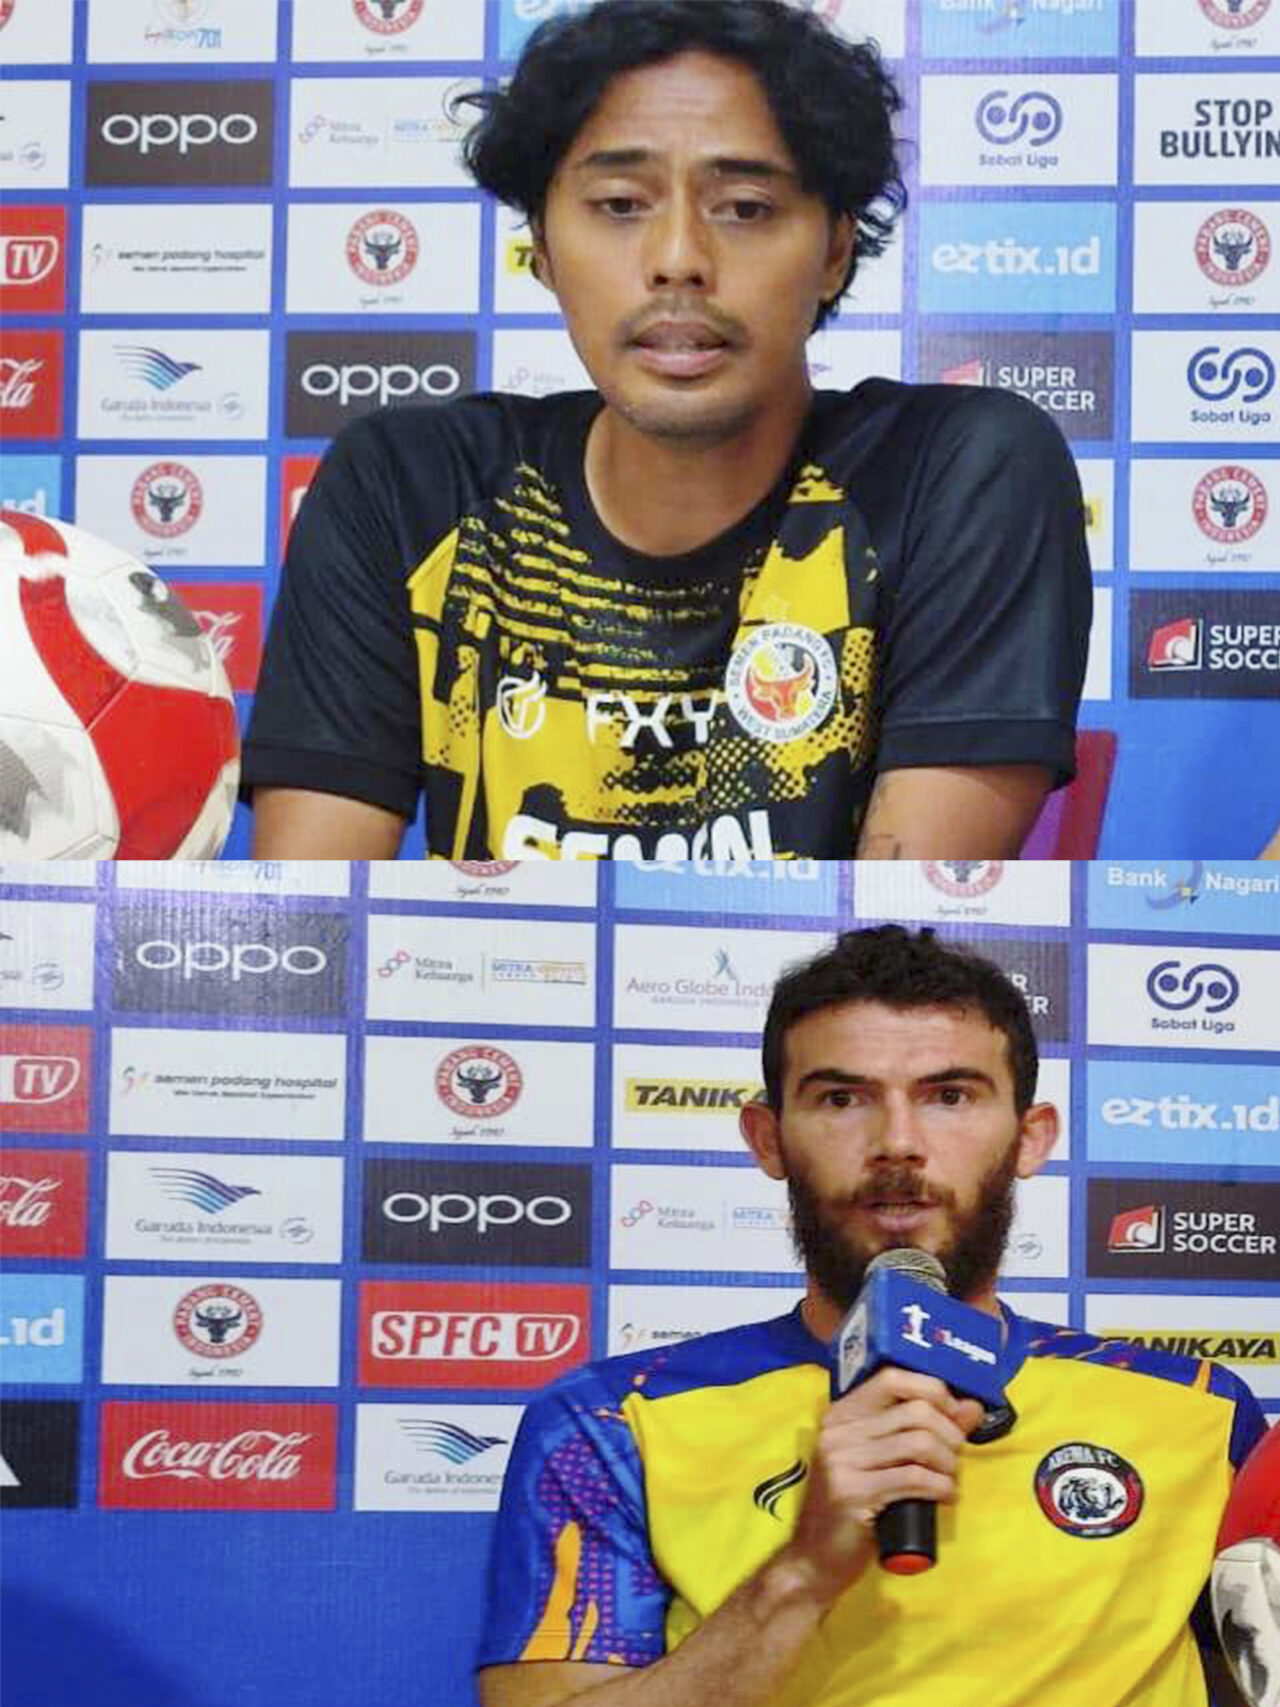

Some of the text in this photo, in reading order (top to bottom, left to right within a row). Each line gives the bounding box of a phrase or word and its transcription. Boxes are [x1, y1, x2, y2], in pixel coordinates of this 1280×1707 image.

[1195, 100, 1273, 127] STOP
[101, 114, 257, 153] oppo
[979, 153, 1058, 168] Sobat Liga
[11, 245, 44, 275] TV
[302, 364, 460, 404] oppo
[998, 367, 1076, 388] SUPER
[1190, 409, 1270, 425] Sobat Liga
[585, 690, 719, 748] FXY
[1108, 867, 1280, 895] Bank Nagari
[136, 940, 327, 980] oppo
[626, 978, 670, 994] Aero
[675, 979, 730, 996] Globe
[1151, 1018, 1235, 1032] Sobat Liga
[19, 1064, 65, 1095] TV
[383, 1192, 571, 1232] oppo
[1173, 1212, 1256, 1234] SUPER
[1173, 1234, 1276, 1255] SOCCER
[378, 1314, 565, 1357] SPFC TV
